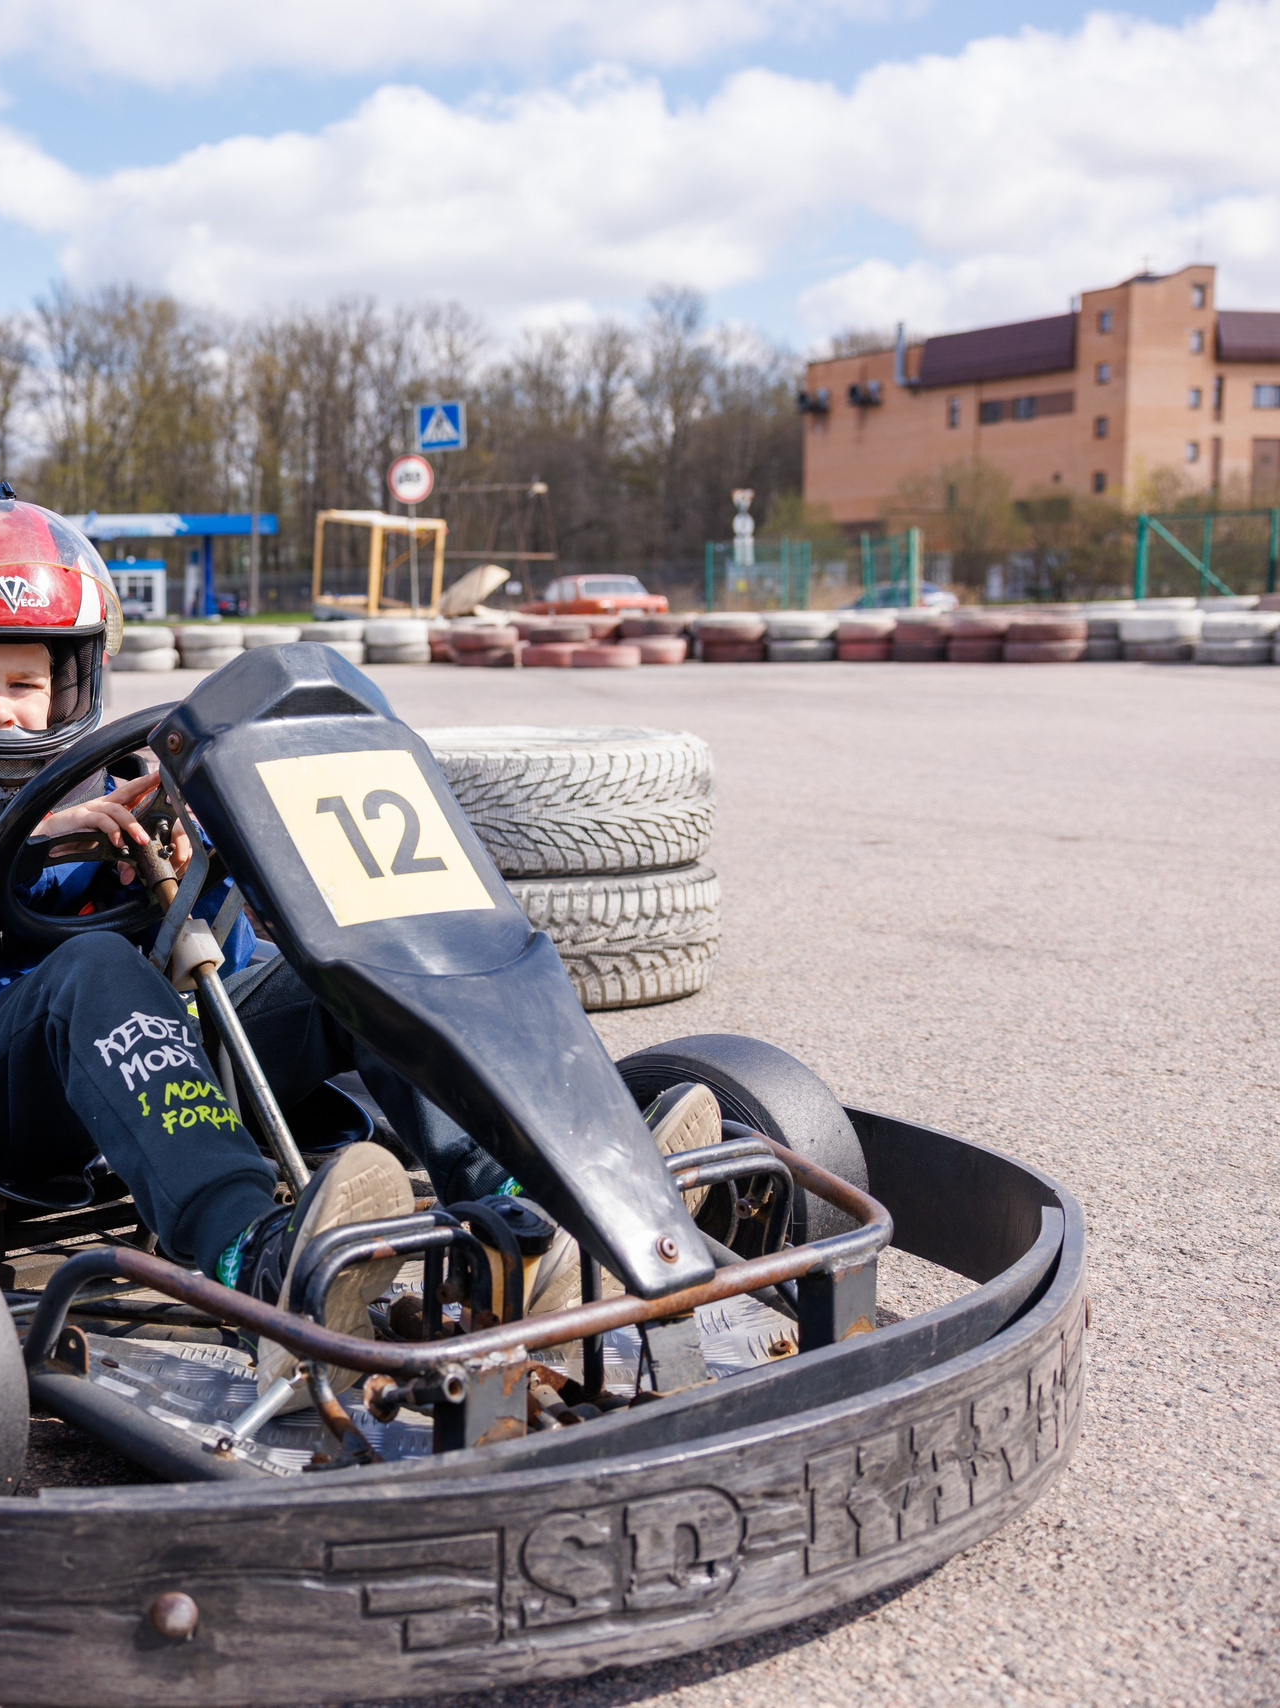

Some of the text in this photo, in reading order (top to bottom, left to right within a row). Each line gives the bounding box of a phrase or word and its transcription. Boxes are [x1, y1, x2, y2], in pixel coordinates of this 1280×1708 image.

[12, 598, 43, 608] VEGA
[316, 789, 449, 880] 12
[93, 1011, 197, 1067] REBEL
[119, 1045, 202, 1091] MODE
[137, 1092, 151, 1117] I
